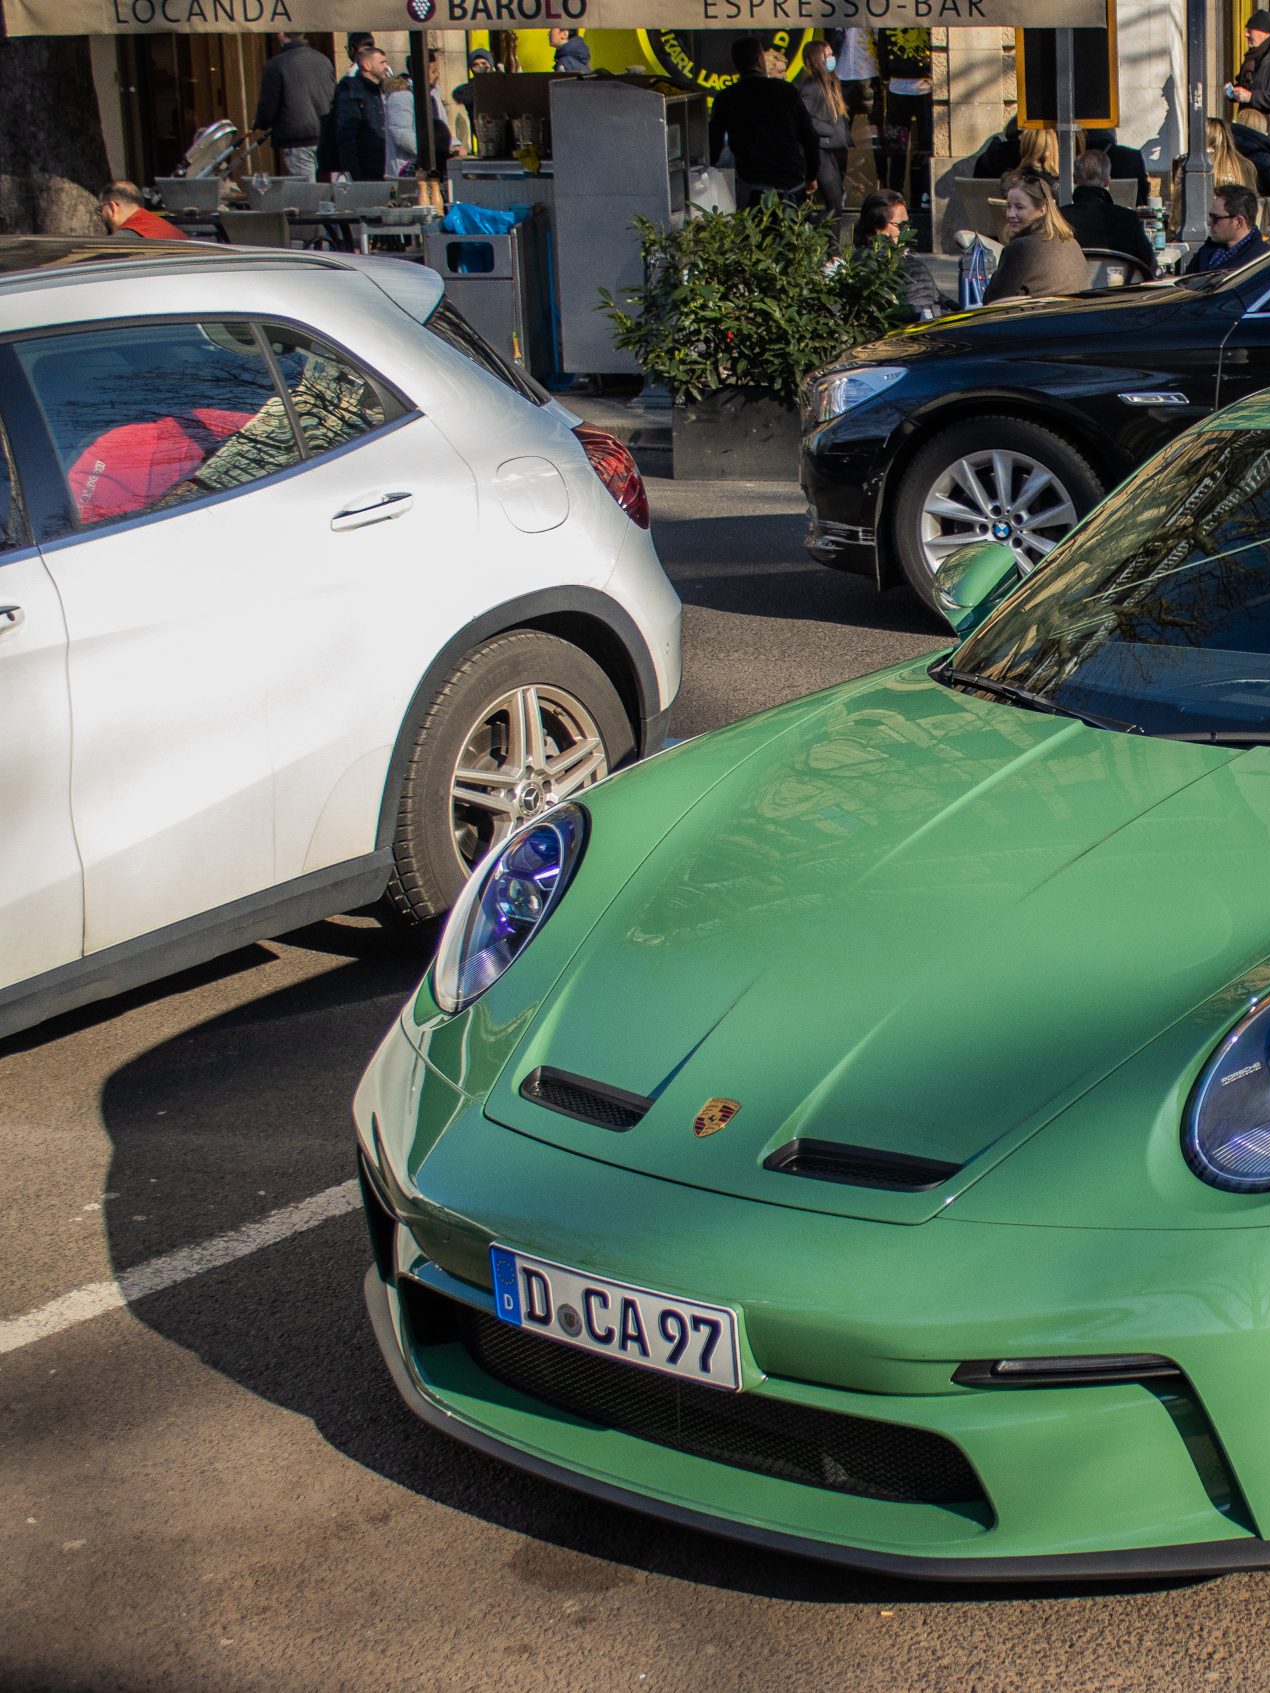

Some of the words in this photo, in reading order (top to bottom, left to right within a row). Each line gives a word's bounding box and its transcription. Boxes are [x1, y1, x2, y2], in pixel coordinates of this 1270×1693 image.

[113, 0, 293, 24] LOCANDA
[448, 0, 588, 21] BAROLO
[703, 0, 987, 19] ESPRESSO-BAR
[660, 33, 694, 79] KARL
[503, 1293, 514, 1310] D
[522, 1264, 554, 1327] D
[583, 1286, 651, 1358] CA
[658, 1307, 723, 1374] 97
